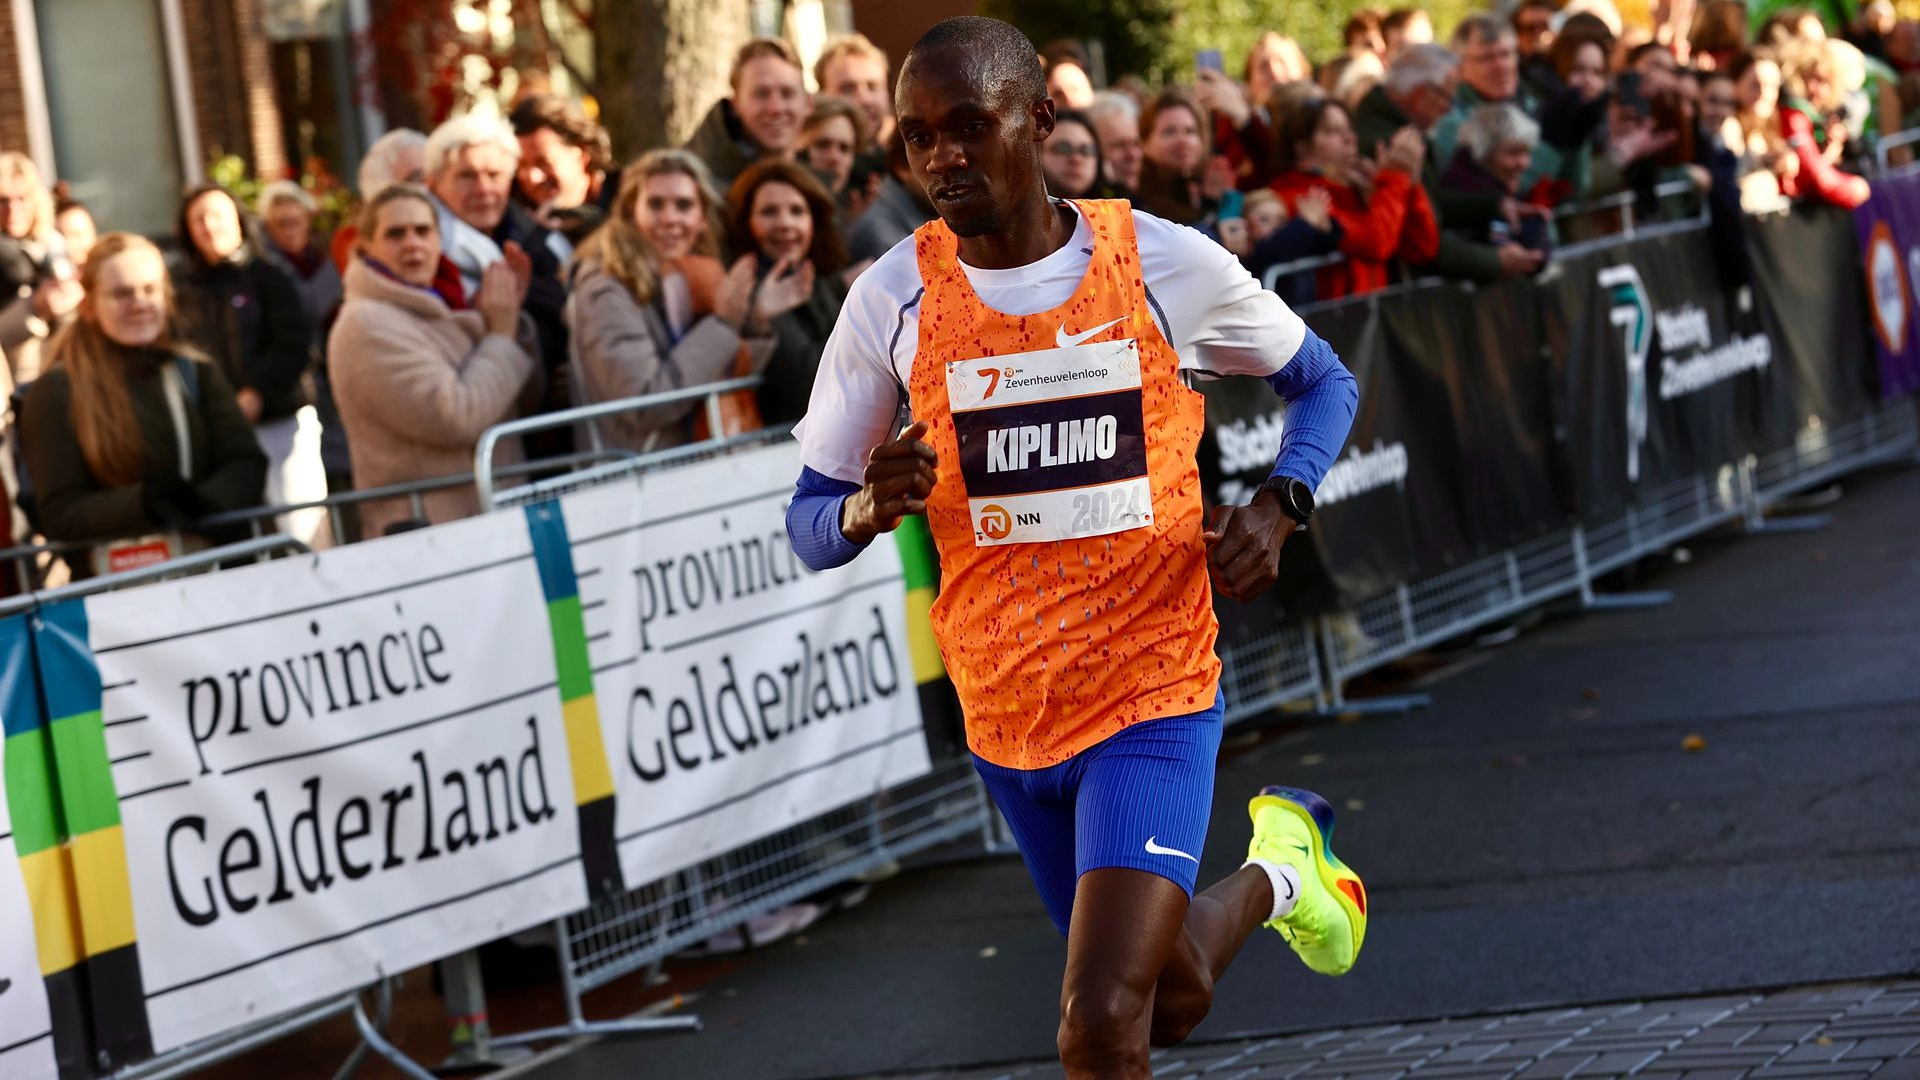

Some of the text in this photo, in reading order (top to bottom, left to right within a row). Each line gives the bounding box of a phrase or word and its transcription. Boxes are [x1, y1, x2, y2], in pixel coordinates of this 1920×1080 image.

[976, 367, 1001, 400] 7
[1004, 368, 1108, 389] Zevenheuvelenloop
[986, 414, 1117, 473] KIPLIMO
[1016, 512, 1041, 526] NN
[1071, 485, 1142, 534] 2024
[631, 503, 801, 655] provinci
[181, 601, 452, 776] provincie
[626, 605, 899, 783] Gelderland
[165, 714, 555, 927] Gelderland
